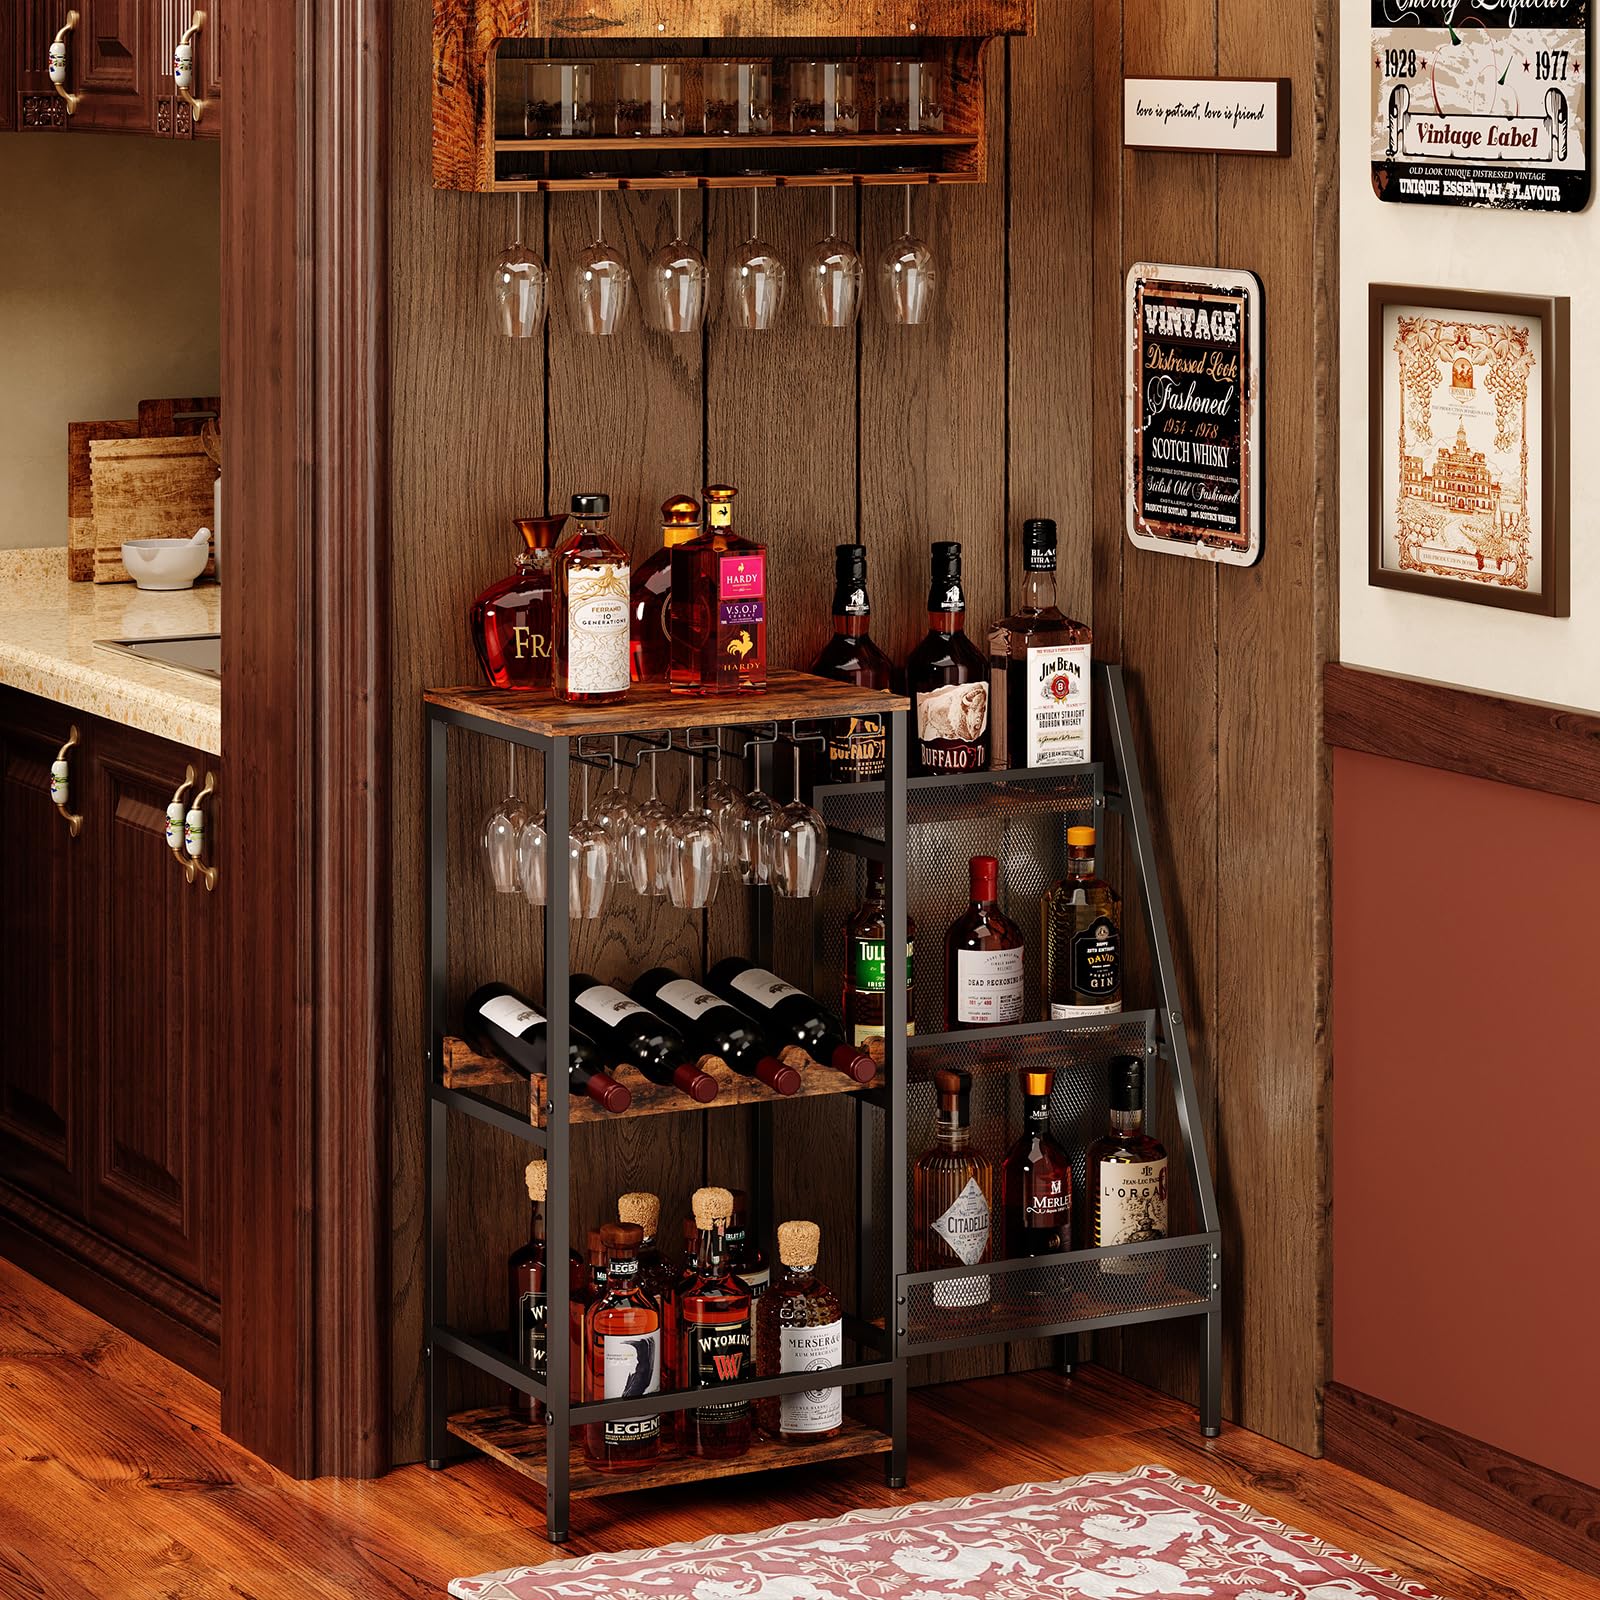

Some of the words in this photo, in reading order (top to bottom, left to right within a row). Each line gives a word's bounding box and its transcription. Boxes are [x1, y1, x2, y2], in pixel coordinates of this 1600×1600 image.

[1384, 49, 1417, 78] 1928
[1535, 51, 1569, 81] 1977
[1136, 99, 1153, 117] love
[1155, 104, 1164, 117] is
[1164, 102, 1200, 125] patient,
[1203, 101, 1221, 118] love
[1224, 105, 1233, 119] is
[1416, 122, 1482, 148] Vintage
[1486, 125, 1539, 148] Label
[1408, 167, 1423, 175] OLD
[1424, 167, 1443, 176] LOOK
[1444, 168, 1472, 179] UNIQUE
[1472, 170, 1514, 179] DISTRESSED
[1514, 172, 1546, 180] VINTAGE
[1399, 178, 1440, 197] UNIQUE
[1443, 179, 1506, 201] ESSENTIAL
[1507, 181, 1561, 202] FLAVOUR
[1144, 304, 1237, 342] VINTAGE
[1145, 343, 1208, 374] Distressed
[1206, 351, 1238, 382] Look
[1147, 375, 1234, 416] Fashoned
[1195, 422, 1219, 438] 1978
[1152, 436, 1190, 463] SCOTCH
[1192, 442, 1230, 468] WHISKY
[1174, 480, 1192, 496] Old
[1192, 482, 1240, 504] Fashioned
[726, 574, 758, 584] HARDY
[726, 604, 758, 614] V.S.O.P
[724, 663, 760, 672] HARDY
[1040, 662, 1056, 682] JIM
[1057, 656, 1080, 678] BEAM
[921, 744, 967, 768] BUFFALO
[1088, 954, 1115, 964] DAVID
[986, 976, 1018, 987] RECKONING
[1090, 977, 1114, 988] GIN
[948, 1214, 988, 1234] CITADELLE
[698, 1334, 750, 1352] WYOMING
